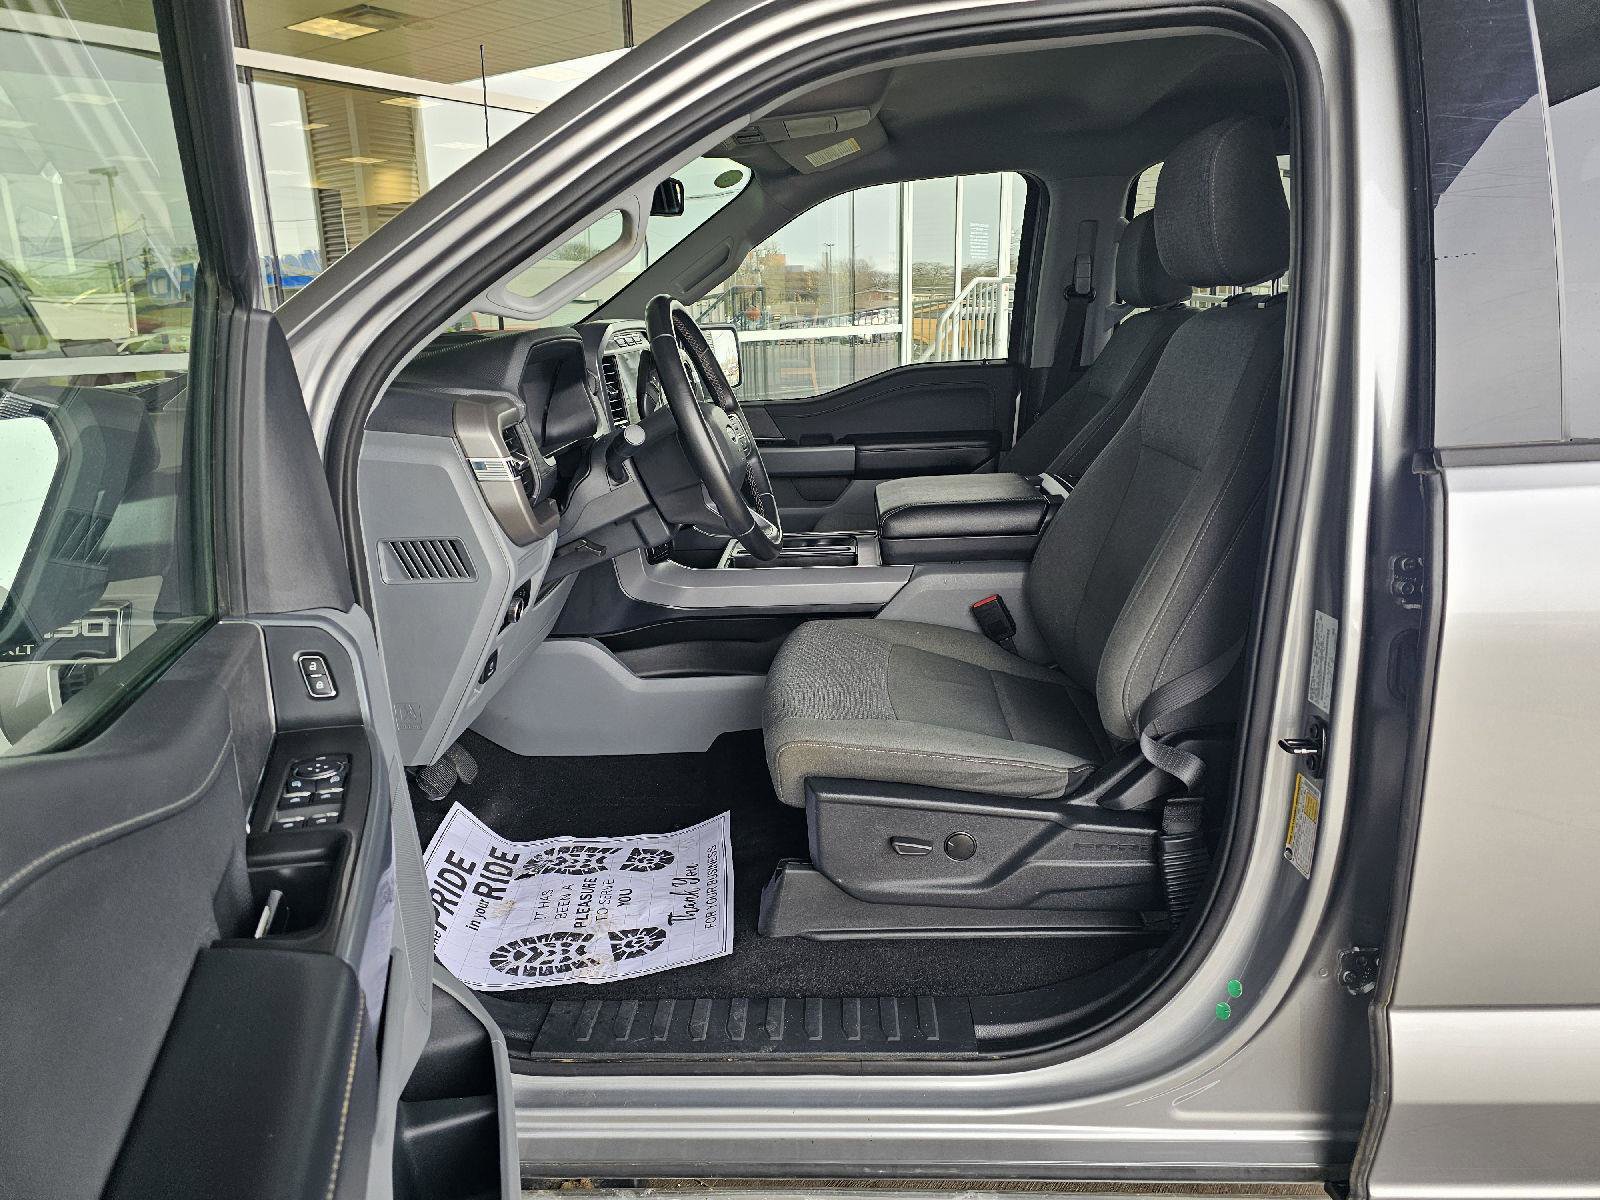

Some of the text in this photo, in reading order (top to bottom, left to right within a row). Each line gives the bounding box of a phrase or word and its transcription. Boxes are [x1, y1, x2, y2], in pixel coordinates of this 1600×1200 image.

[43, 617, 111, 638] 50
[465, 846, 520, 931] in your RIDE
[534, 889, 554, 921] IT HAS
[554, 883, 575, 920] BEEN A
[573, 877, 598, 928] PLEASURE
[596, 879, 615, 921] TO SERVE
[617, 888, 633, 908] YOU
[667, 863, 701, 926] Thank You
[705, 844, 718, 929] FOR YOUR BUSINESS
